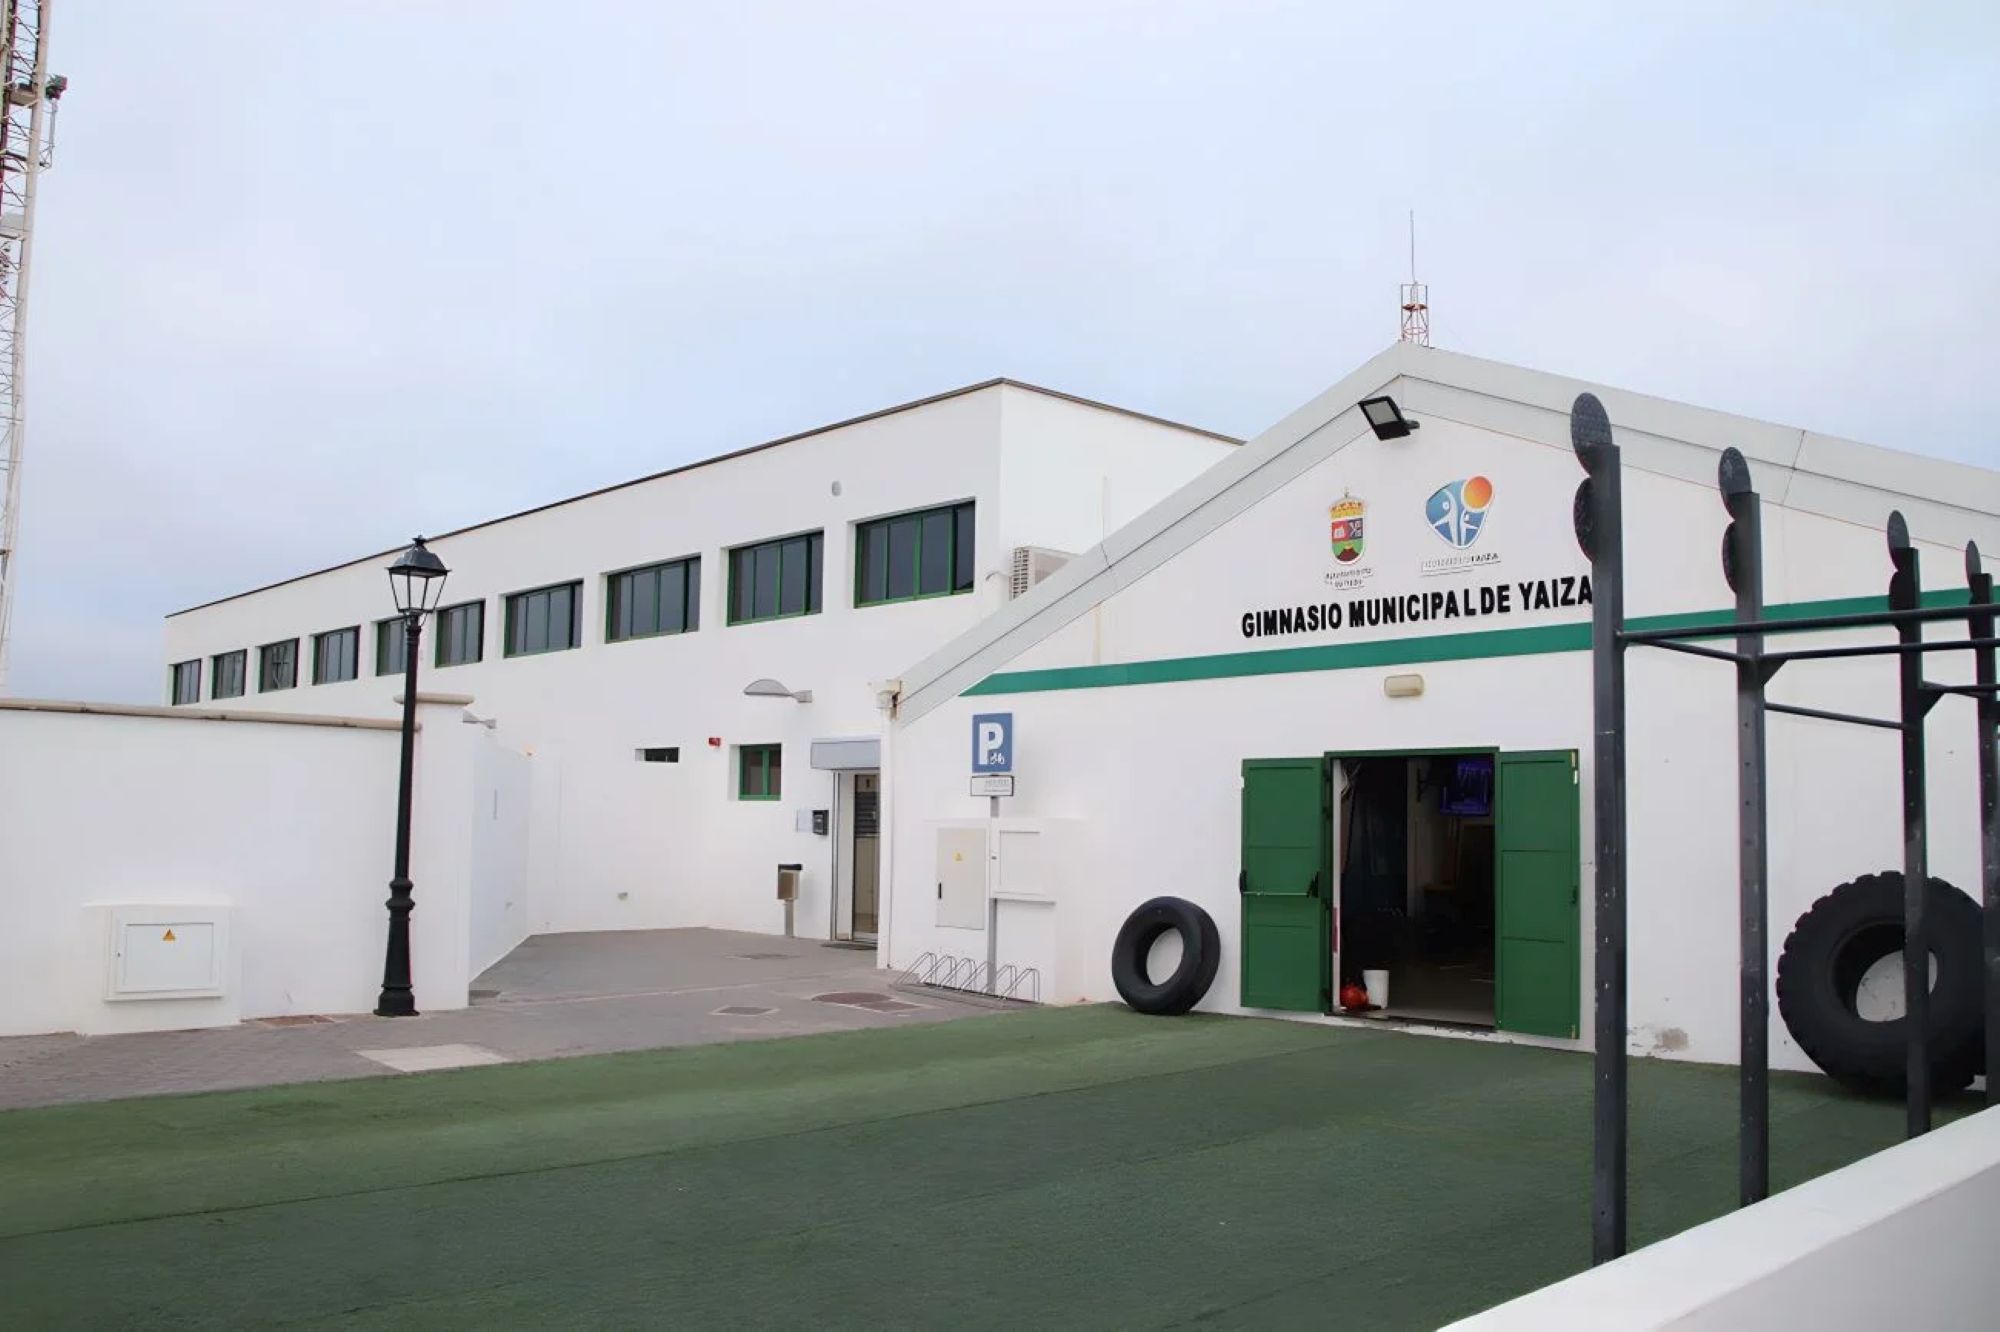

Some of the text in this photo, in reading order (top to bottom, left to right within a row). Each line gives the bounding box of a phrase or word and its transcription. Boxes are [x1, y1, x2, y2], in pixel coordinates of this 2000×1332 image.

[1242, 575, 1593, 638] GIMNASIO MUNICIPAL DE YAIZA
[979, 722, 1004, 765] P
